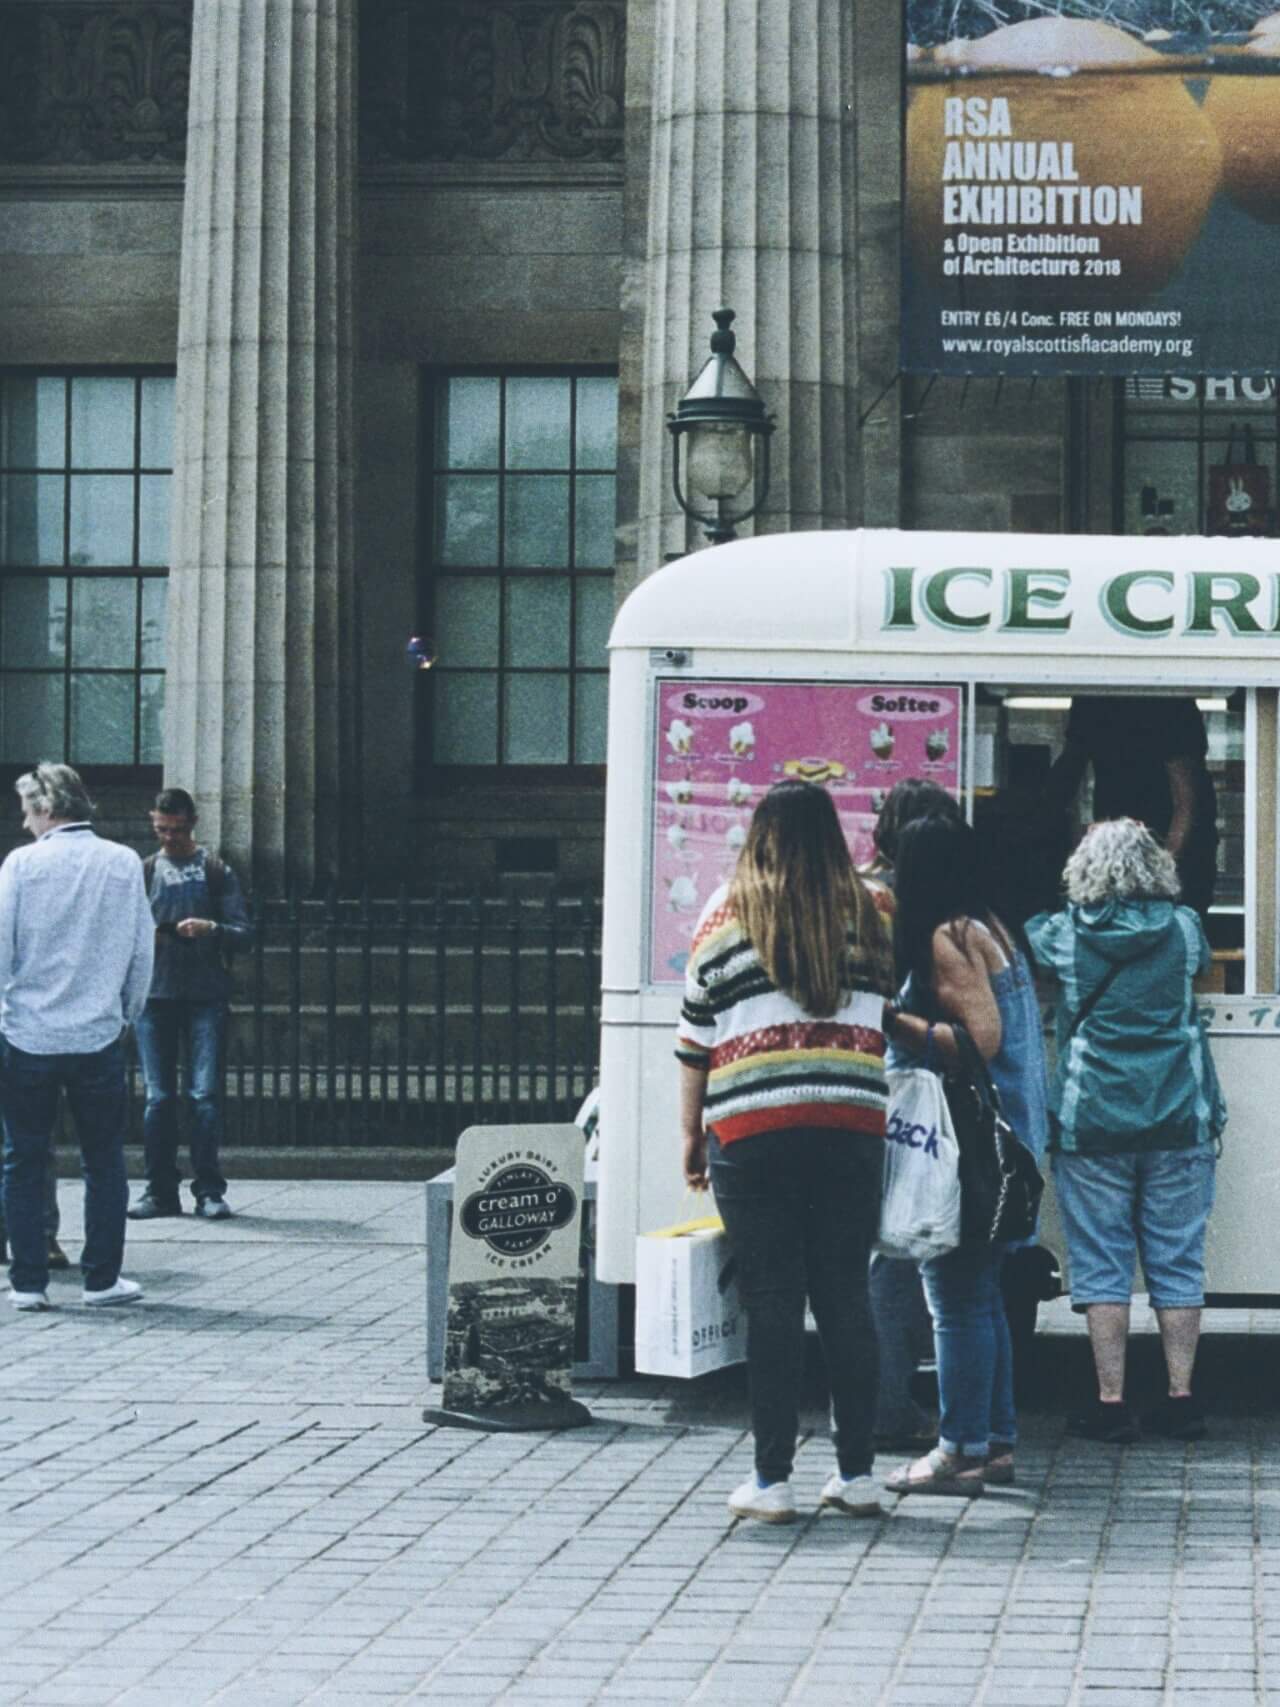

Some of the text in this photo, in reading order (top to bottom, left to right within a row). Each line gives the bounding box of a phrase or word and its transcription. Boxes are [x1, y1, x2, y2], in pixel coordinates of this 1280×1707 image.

[944, 97, 1012, 136] RSA
[942, 141, 1079, 181] ANNUAL
[943, 185, 1143, 225] EXHIBITION
[958, 233, 1002, 254] Open
[1007, 233, 1100, 253] Exhibition
[943, 256, 1121, 276] of Architecture 2018
[941, 310, 979, 326] ENTRY
[1060, 311, 1090, 327] FREE
[1094, 311, 1111, 327] ON
[1115, 311, 1181, 327] MONDAYS!
[942, 333, 1193, 357] www.royalscottishacademy.org
[881, 567, 1073, 633] ICE
[683, 692, 749, 713] Scoop
[870, 695, 941, 713] Softee
[478, 1151, 521, 1183] LUXURY
[478, 1193, 538, 1212] cream
[478, 1210, 556, 1231] GALLOWAY
[485, 1243, 552, 1269] ICE CREAM
